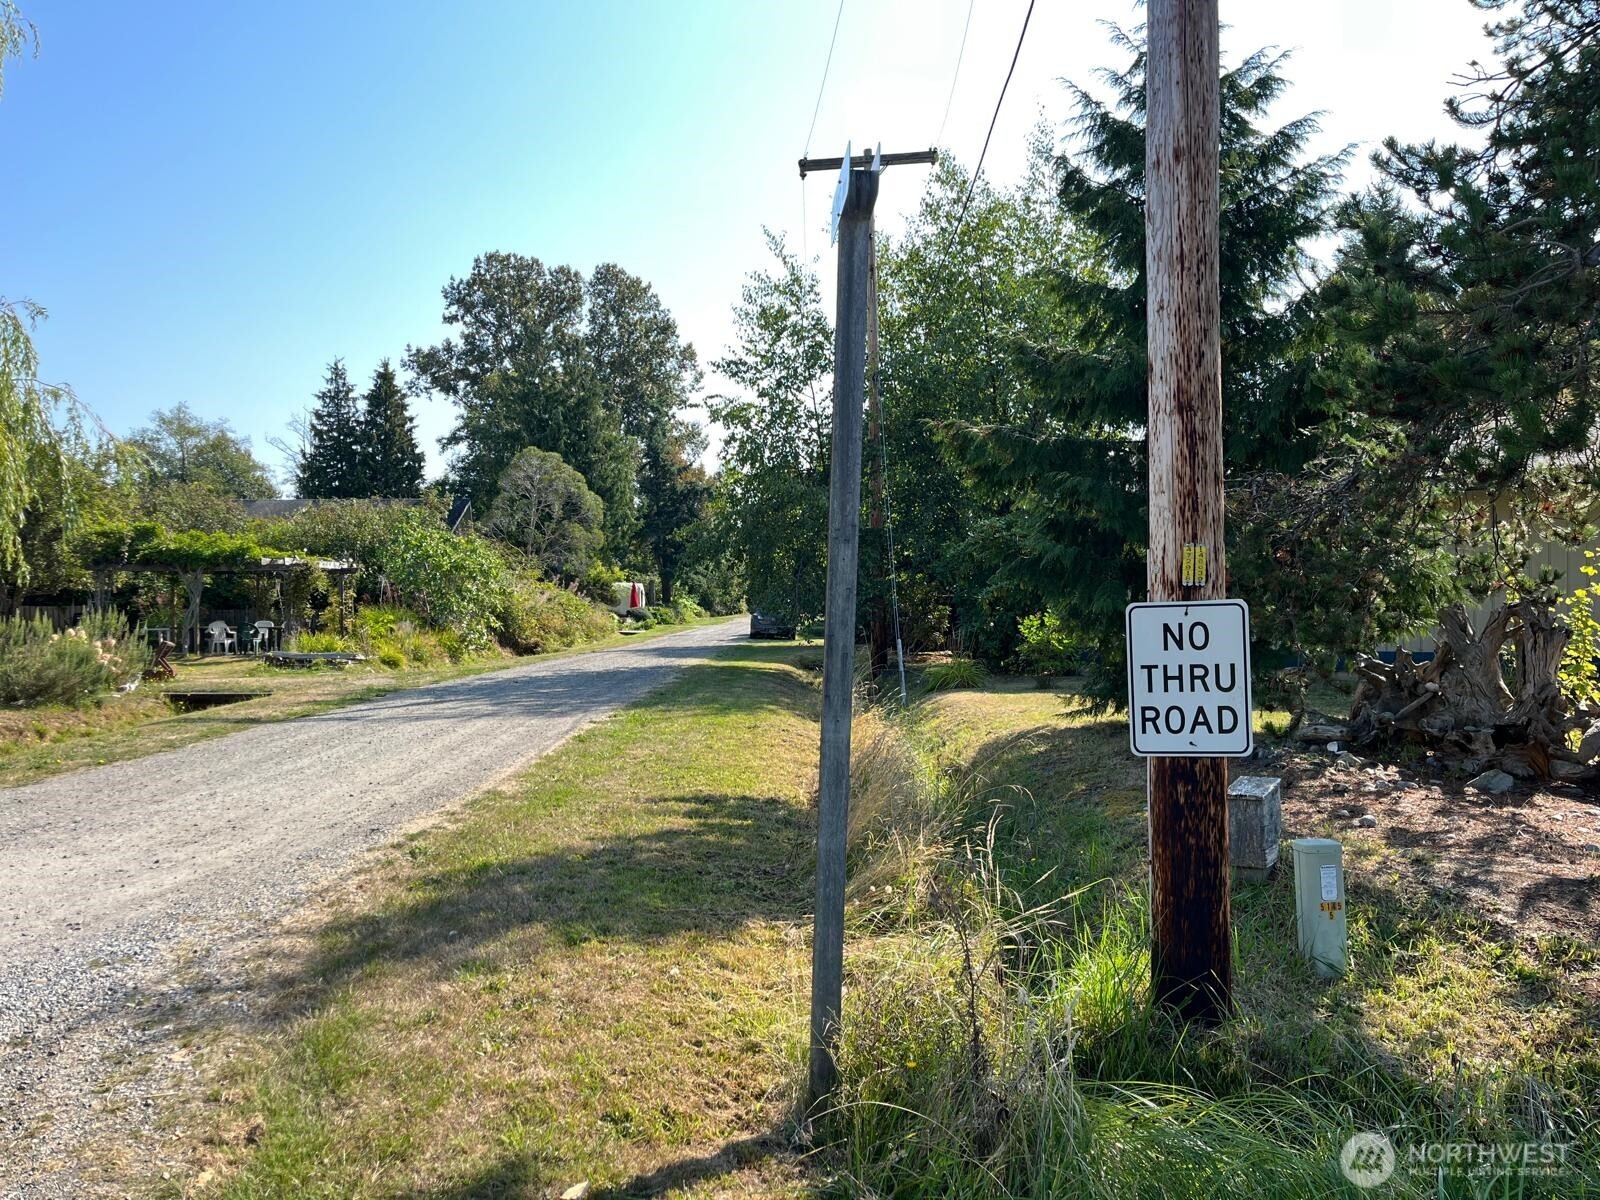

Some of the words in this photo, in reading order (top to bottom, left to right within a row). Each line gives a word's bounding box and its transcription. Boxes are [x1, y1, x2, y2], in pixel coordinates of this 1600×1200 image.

[1162, 621, 1210, 651] NO
[1140, 663, 1236, 693] THRU
[1140, 705, 1239, 735] ROAD
